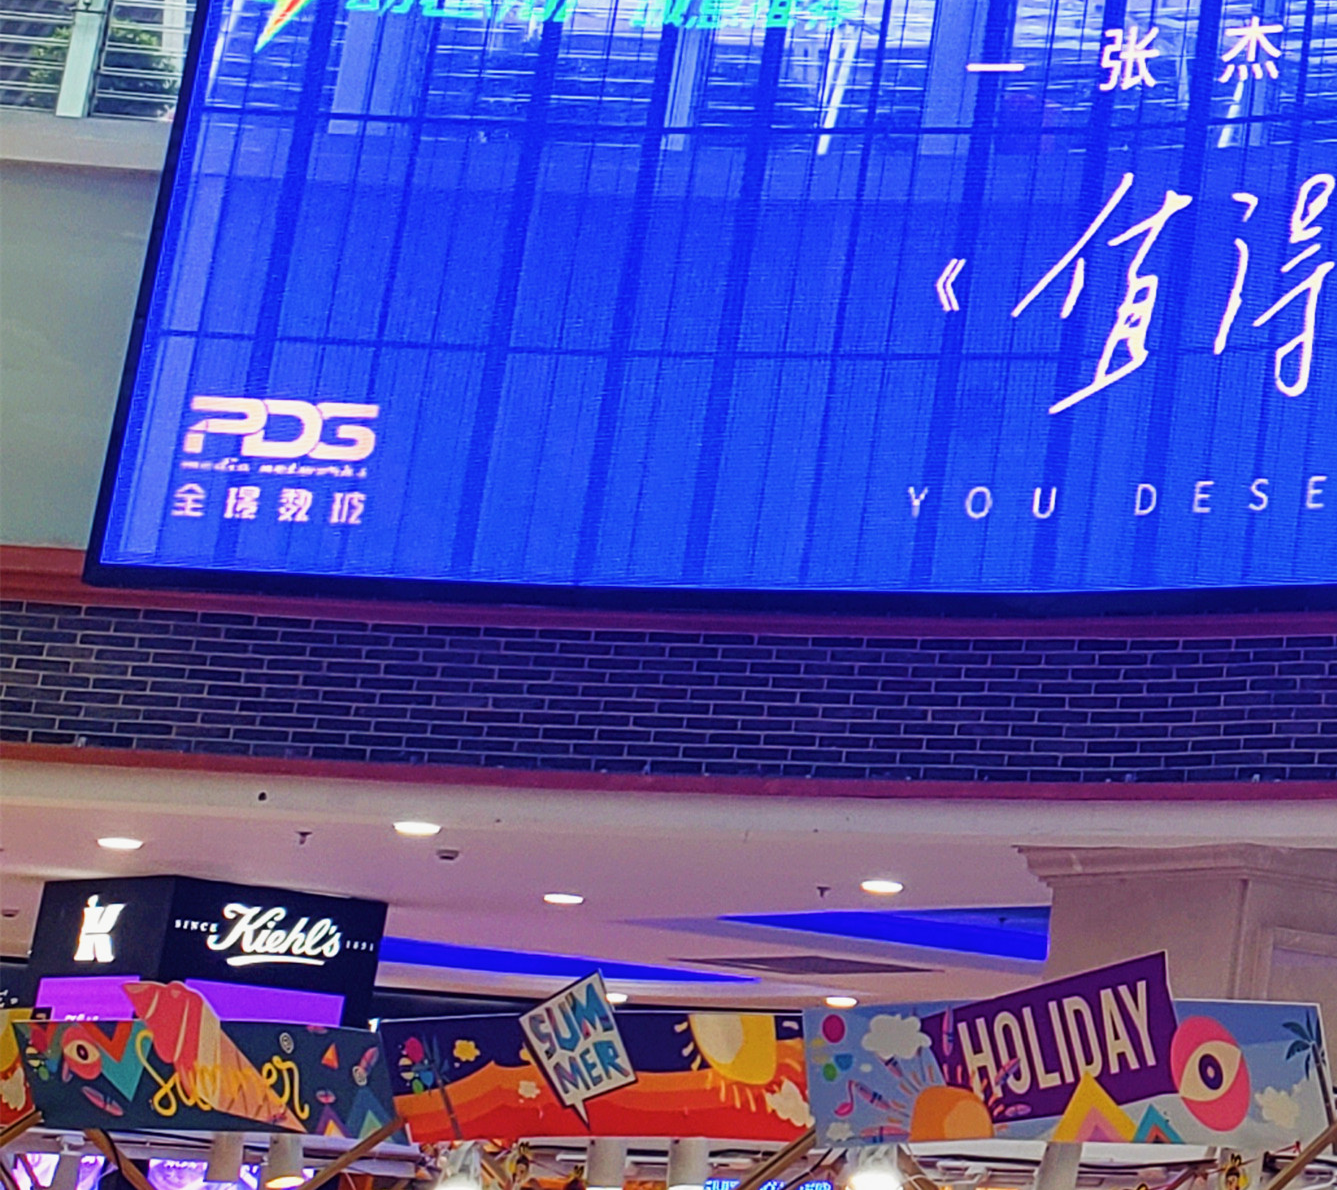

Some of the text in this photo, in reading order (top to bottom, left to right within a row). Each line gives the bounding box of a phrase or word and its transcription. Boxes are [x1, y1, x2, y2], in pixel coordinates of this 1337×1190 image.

[183, 395, 380, 461] PDG
[907, 485, 1057, 519] YOU
[174, 919, 219, 933] SINCE
[206, 902, 341, 959] Kiehl's
[529, 983, 614, 1060] SUM
[958, 980, 1156, 1100] HOLIDAY
[553, 1040, 630, 1095] MER
